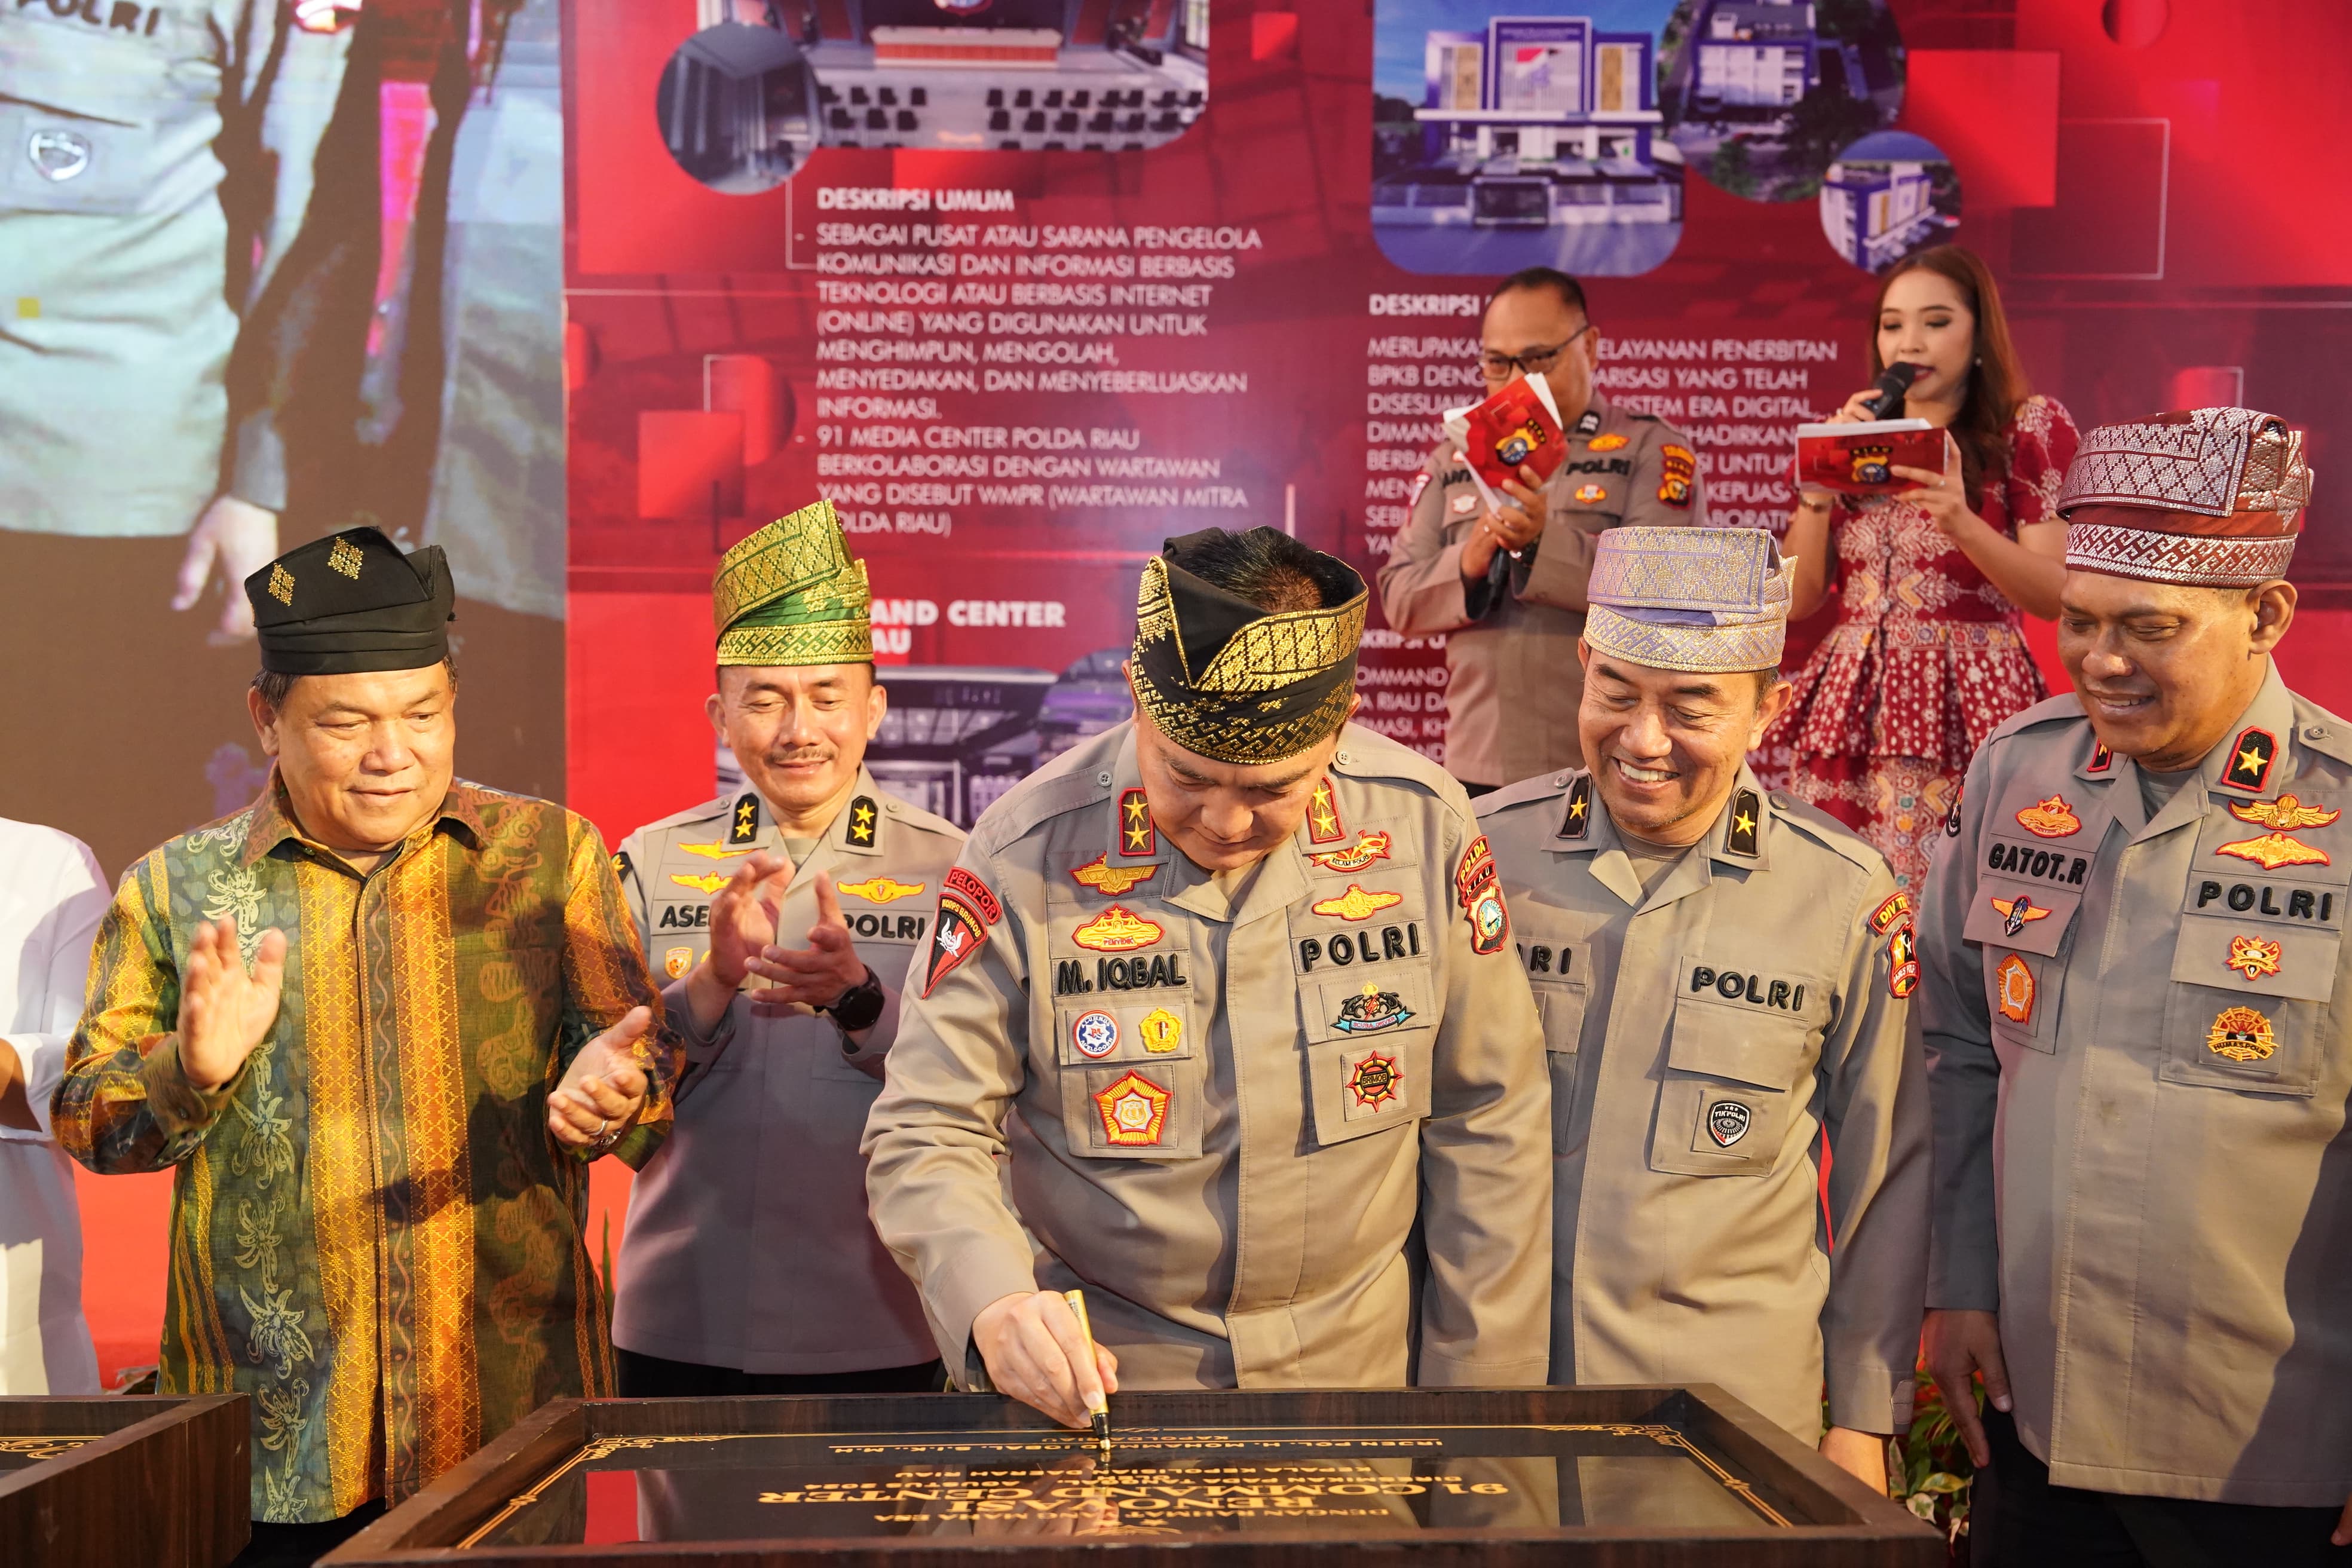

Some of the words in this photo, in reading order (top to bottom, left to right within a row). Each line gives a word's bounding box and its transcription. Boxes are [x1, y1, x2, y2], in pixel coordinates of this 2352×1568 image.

[17, 0, 160, 37] OLRI
[817, 188, 930, 210] DESKRIPSI
[936, 189, 1014, 212] UMUM
[817, 223, 908, 246] SEBAGAI
[912, 224, 979, 247] PUSAT
[982, 225, 1038, 247] ATAU
[1043, 225, 1130, 247] SARANA
[1134, 226, 1262, 249] PENGELOLA
[817, 252, 956, 275] KOMUNIKASI
[961, 253, 1010, 275] DAN
[1015, 255, 1135, 277] INFORMASI
[1140, 256, 1235, 278] BERBASIS
[816, 281, 947, 304] TEKNOLOGI
[951, 283, 1007, 305] ATAU
[1012, 283, 1107, 306] BERBASIS
[1110, 284, 1212, 307] INTERNET
[1369, 294, 1479, 316] DESKRIPSI
[817, 310, 914, 335] (ONLINE)
[919, 311, 984, 334] YANG
[988, 312, 1125, 335] DIGUNAKAN
[1129, 314, 1207, 336] UNTUK
[816, 339, 978, 365] MENGHIMPUN,
[1712, 339, 1838, 361] PENERBITAN
[816, 368, 979, 393] MENYEDIAKAN,
[984, 369, 1034, 391] DAN
[1368, 365, 1420, 387] BPKB
[1591, 367, 1670, 388] ARISASI
[1675, 368, 1738, 389] YANG
[1741, 368, 1808, 390] TELAH
[1689, 396, 1729, 418] ERA
[817, 425, 842, 447] 91
[850, 425, 921, 448] MEDIA
[924, 426, 1008, 449] CENTER
[1012, 427, 1087, 449] POLDA
[1091, 428, 1140, 451] RIAU
[817, 454, 988, 477] BERKOLABORASI
[994, 456, 1091, 478] DENGAN
[1095, 457, 1220, 479] WARTAWAN
[1566, 459, 1631, 476] POLRI
[816, 483, 881, 506] YANG
[886, 483, 975, 506] DISEBUT
[978, 484, 1044, 506] WMPR
[1049, 485, 1178, 512] (WARTAWAN
[1183, 486, 1248, 508] MITRA
[897, 511, 951, 538] RIAU)
[947, 600, 1066, 627] CENTER
[1377, 691, 1421, 712] RIAU
[1460, 840, 1486, 883] POLDA
[1989, 843, 2087, 884] GATOT.R
[1466, 867, 1490, 896] RIAU
[949, 872, 996, 918] PELOPOR
[2197, 880, 2333, 921] POLRI
[659, 905, 710, 928] ASE
[942, 898, 960, 912] KORPS
[958, 907, 981, 937] BRIMOB
[1879, 901, 1896, 924] DIV
[1299, 923, 1420, 972] POLRI
[1517, 943, 1572, 975] RI
[1058, 960, 1094, 994] M.
[1098, 954, 1187, 991] IQBAL
[1691, 966, 1805, 1012] POLRI
[2214, 1042, 2244, 1051] HUMAS
[2245, 1044, 2267, 1056] POLRI
[1362, 1074, 1387, 1085] BRIMOB
[758, 1488, 1034, 1503] CENTER
[1050, 1484, 1426, 1498] COMMAND
[1443, 1483, 1509, 1494] 91
[946, 1497, 1319, 1512] RENOVASI
